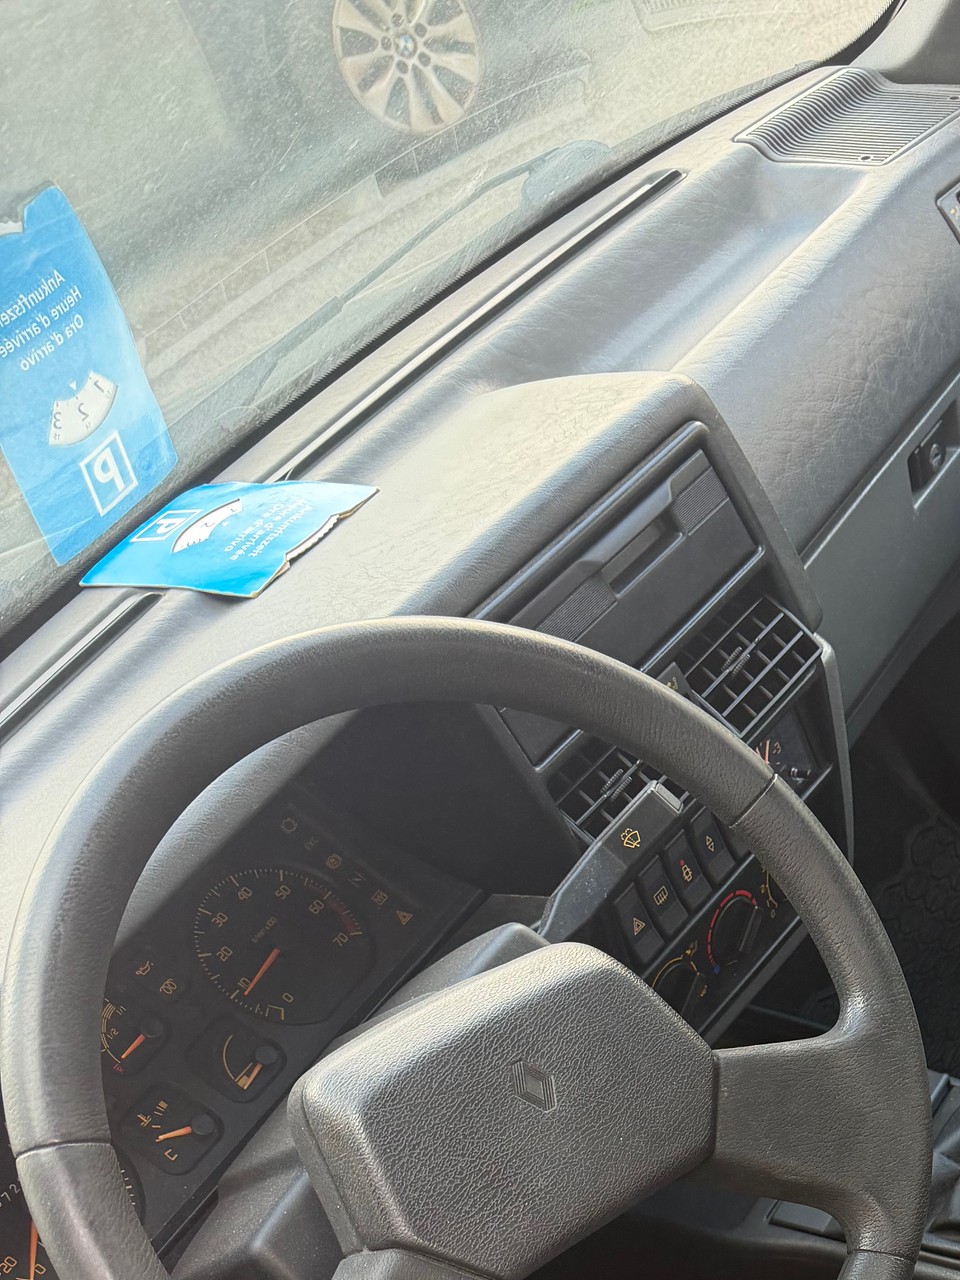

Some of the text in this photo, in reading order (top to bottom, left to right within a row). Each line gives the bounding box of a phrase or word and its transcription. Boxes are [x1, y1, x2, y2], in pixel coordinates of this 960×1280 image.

[155, 518, 189, 534] P
[237, 886, 253, 901] 40
[275, 885, 291, 901] 50
[308, 899, 324, 915] 60
[211, 912, 228, 928] 30
[333, 932, 349, 947] 70
[216, 946, 233, 962] 20
[237, 977, 251, 991] 10
[282, 992, 294, 1004] 0
[106, 1028, 119, 1040] 1/2
[0, 1256, 18, 1274] 20
[34, 1263, 46, 1275] 0
